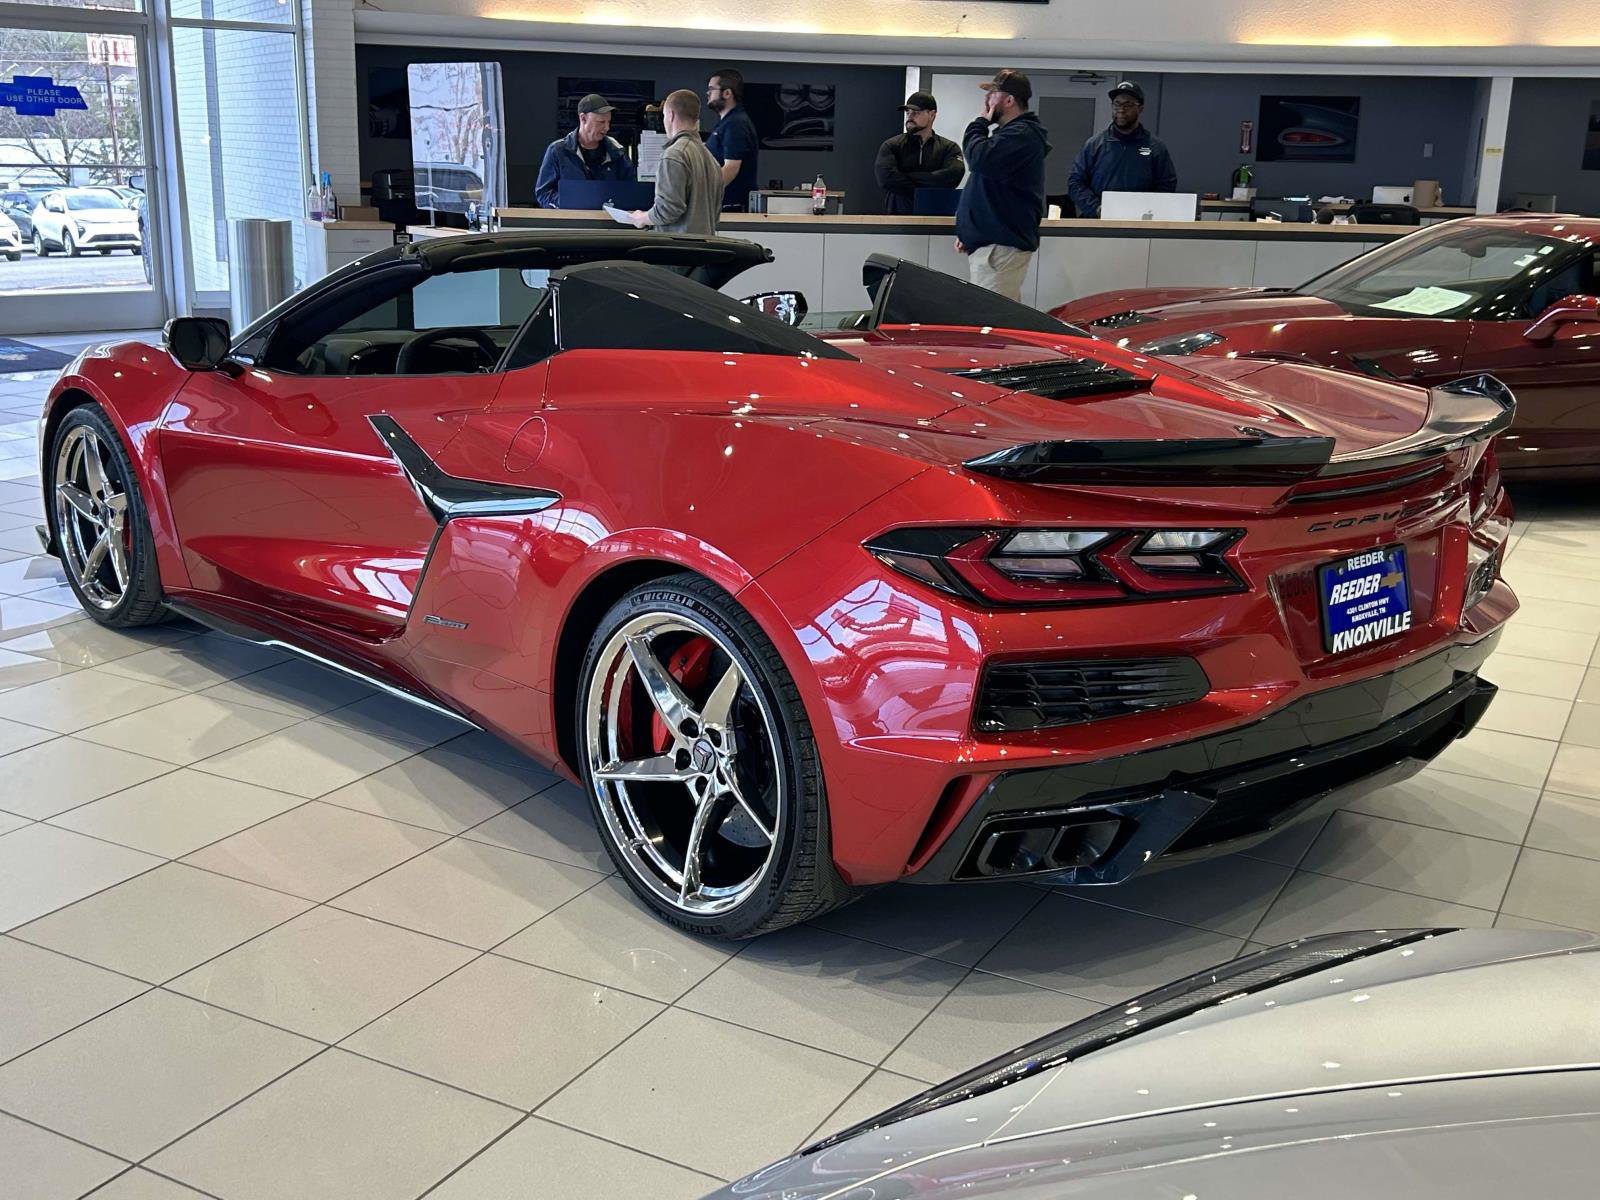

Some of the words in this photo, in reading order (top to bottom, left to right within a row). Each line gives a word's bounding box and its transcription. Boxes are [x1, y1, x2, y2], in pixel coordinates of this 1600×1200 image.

[26, 95, 56, 103] OTHER
[27, 88, 60, 96] PLEASE
[1347, 550, 1385, 571] REEDER
[1329, 573, 1381, 605] REEDER
[643, 592, 695, 607] MICHELIN
[1358, 600, 1378, 611] CLINTON
[1332, 610, 1412, 654] KNOXVILLE
